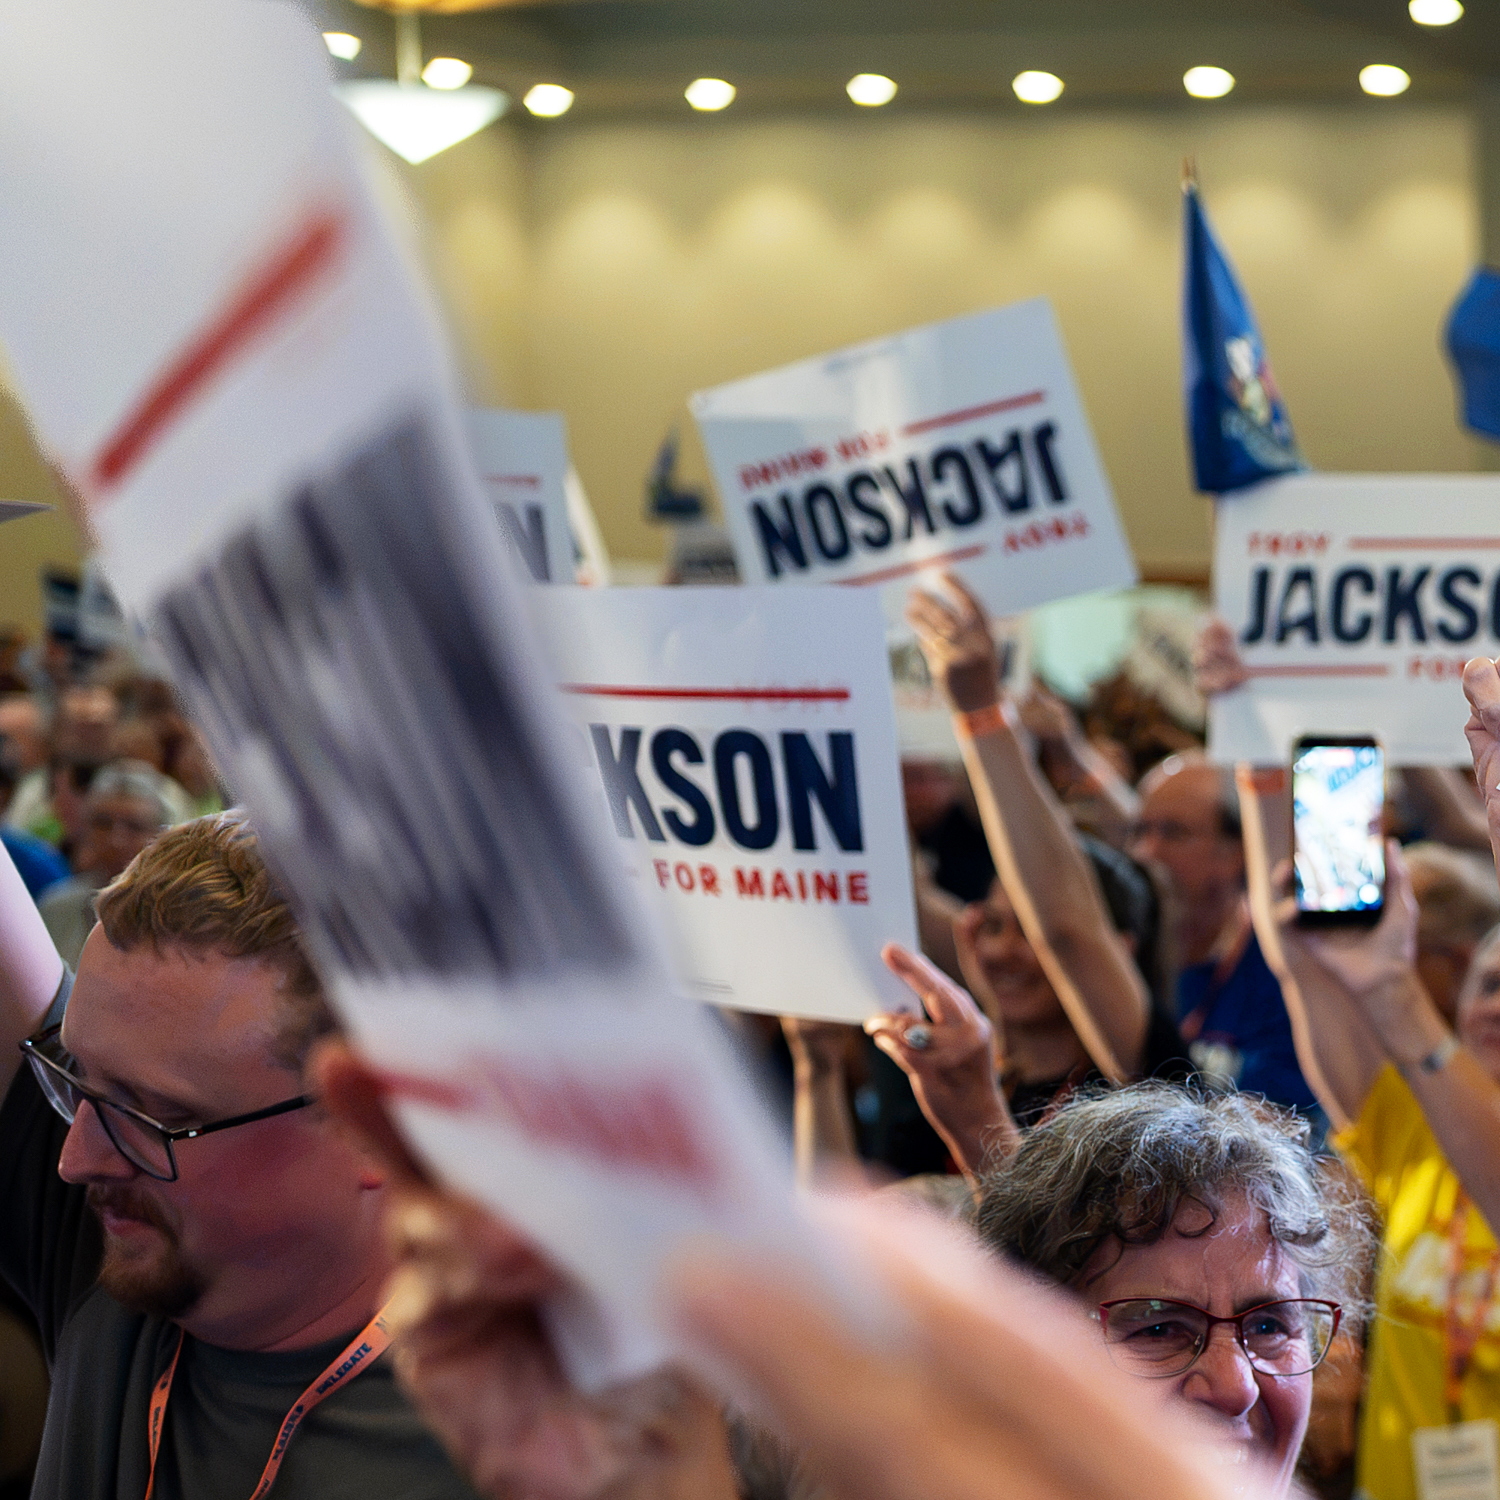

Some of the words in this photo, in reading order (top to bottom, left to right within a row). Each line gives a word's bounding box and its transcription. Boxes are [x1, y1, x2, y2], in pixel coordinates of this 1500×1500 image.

[748, 418, 1070, 581] JACKSON
[587, 722, 866, 854] KSON
[653, 858, 722, 897] FOR
[733, 865, 871, 906] MAINE
